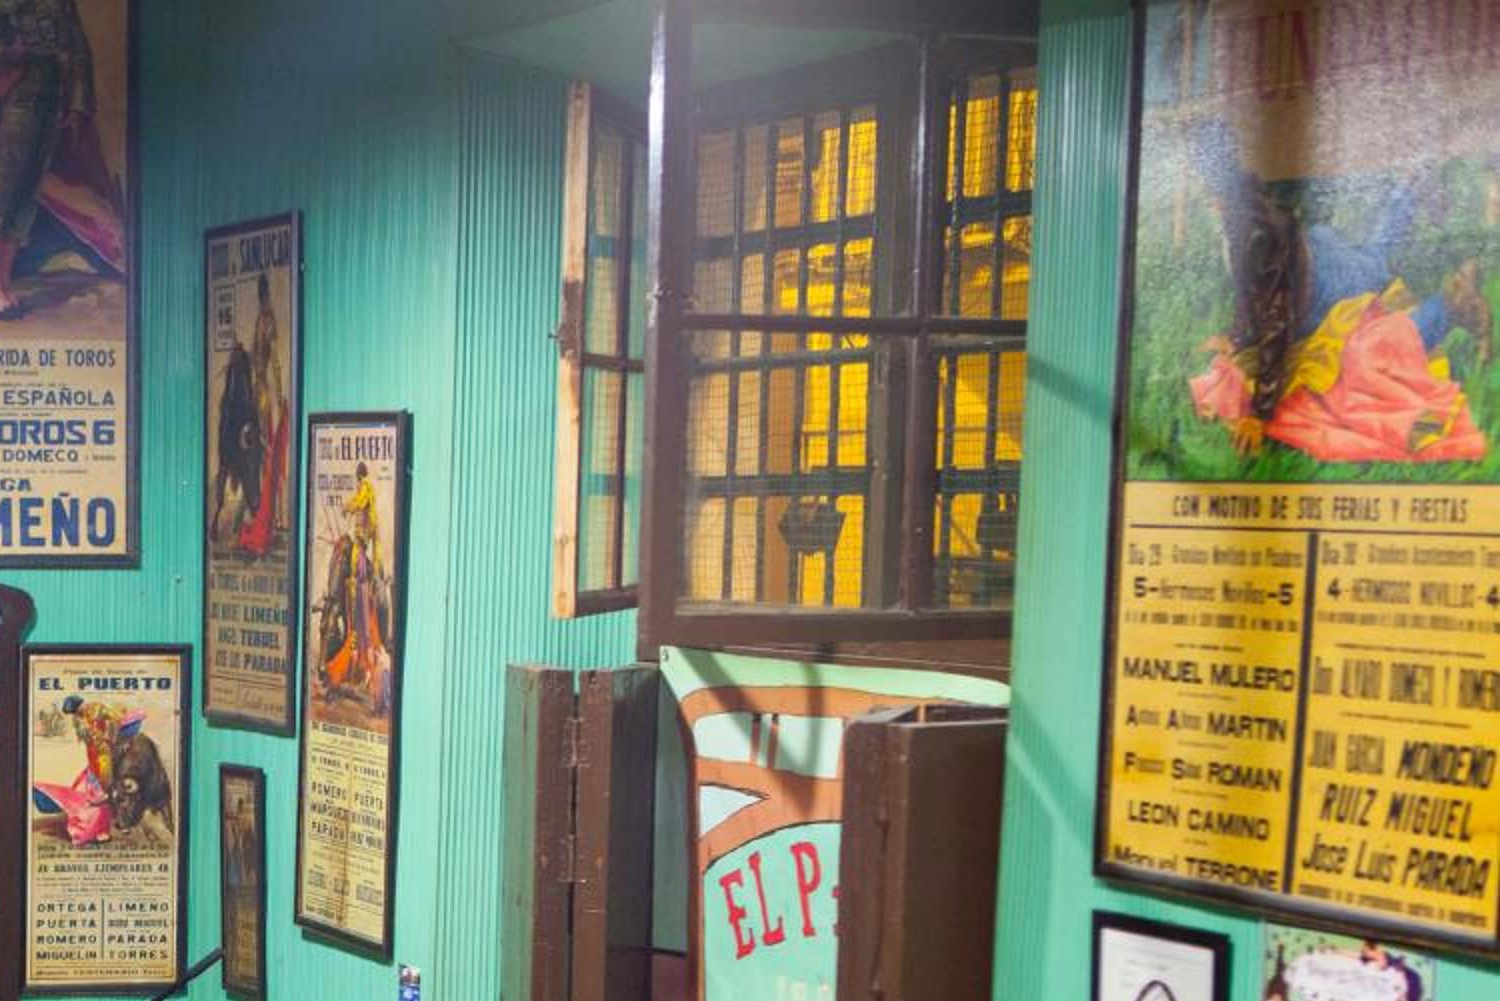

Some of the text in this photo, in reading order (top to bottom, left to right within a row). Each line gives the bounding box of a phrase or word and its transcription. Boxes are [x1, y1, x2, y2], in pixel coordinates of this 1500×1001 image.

[39, 349, 57, 367] DE
[66, 349, 116, 368] TOROS
[3, 387, 116, 406] ESPAÑOLA
[93, 420, 116, 445] 6
[39, 677, 171, 690] EL PUERTO
[1123, 657, 1294, 692] MANUEL MULERO
[1207, 712, 1287, 742] MARTIN
[1207, 761, 1283, 792] ROMAN
[1128, 800, 1269, 841] LEON CAMINO
[1321, 783, 1473, 843] RUIZ MIGUEL
[719, 851, 786, 960] EL
